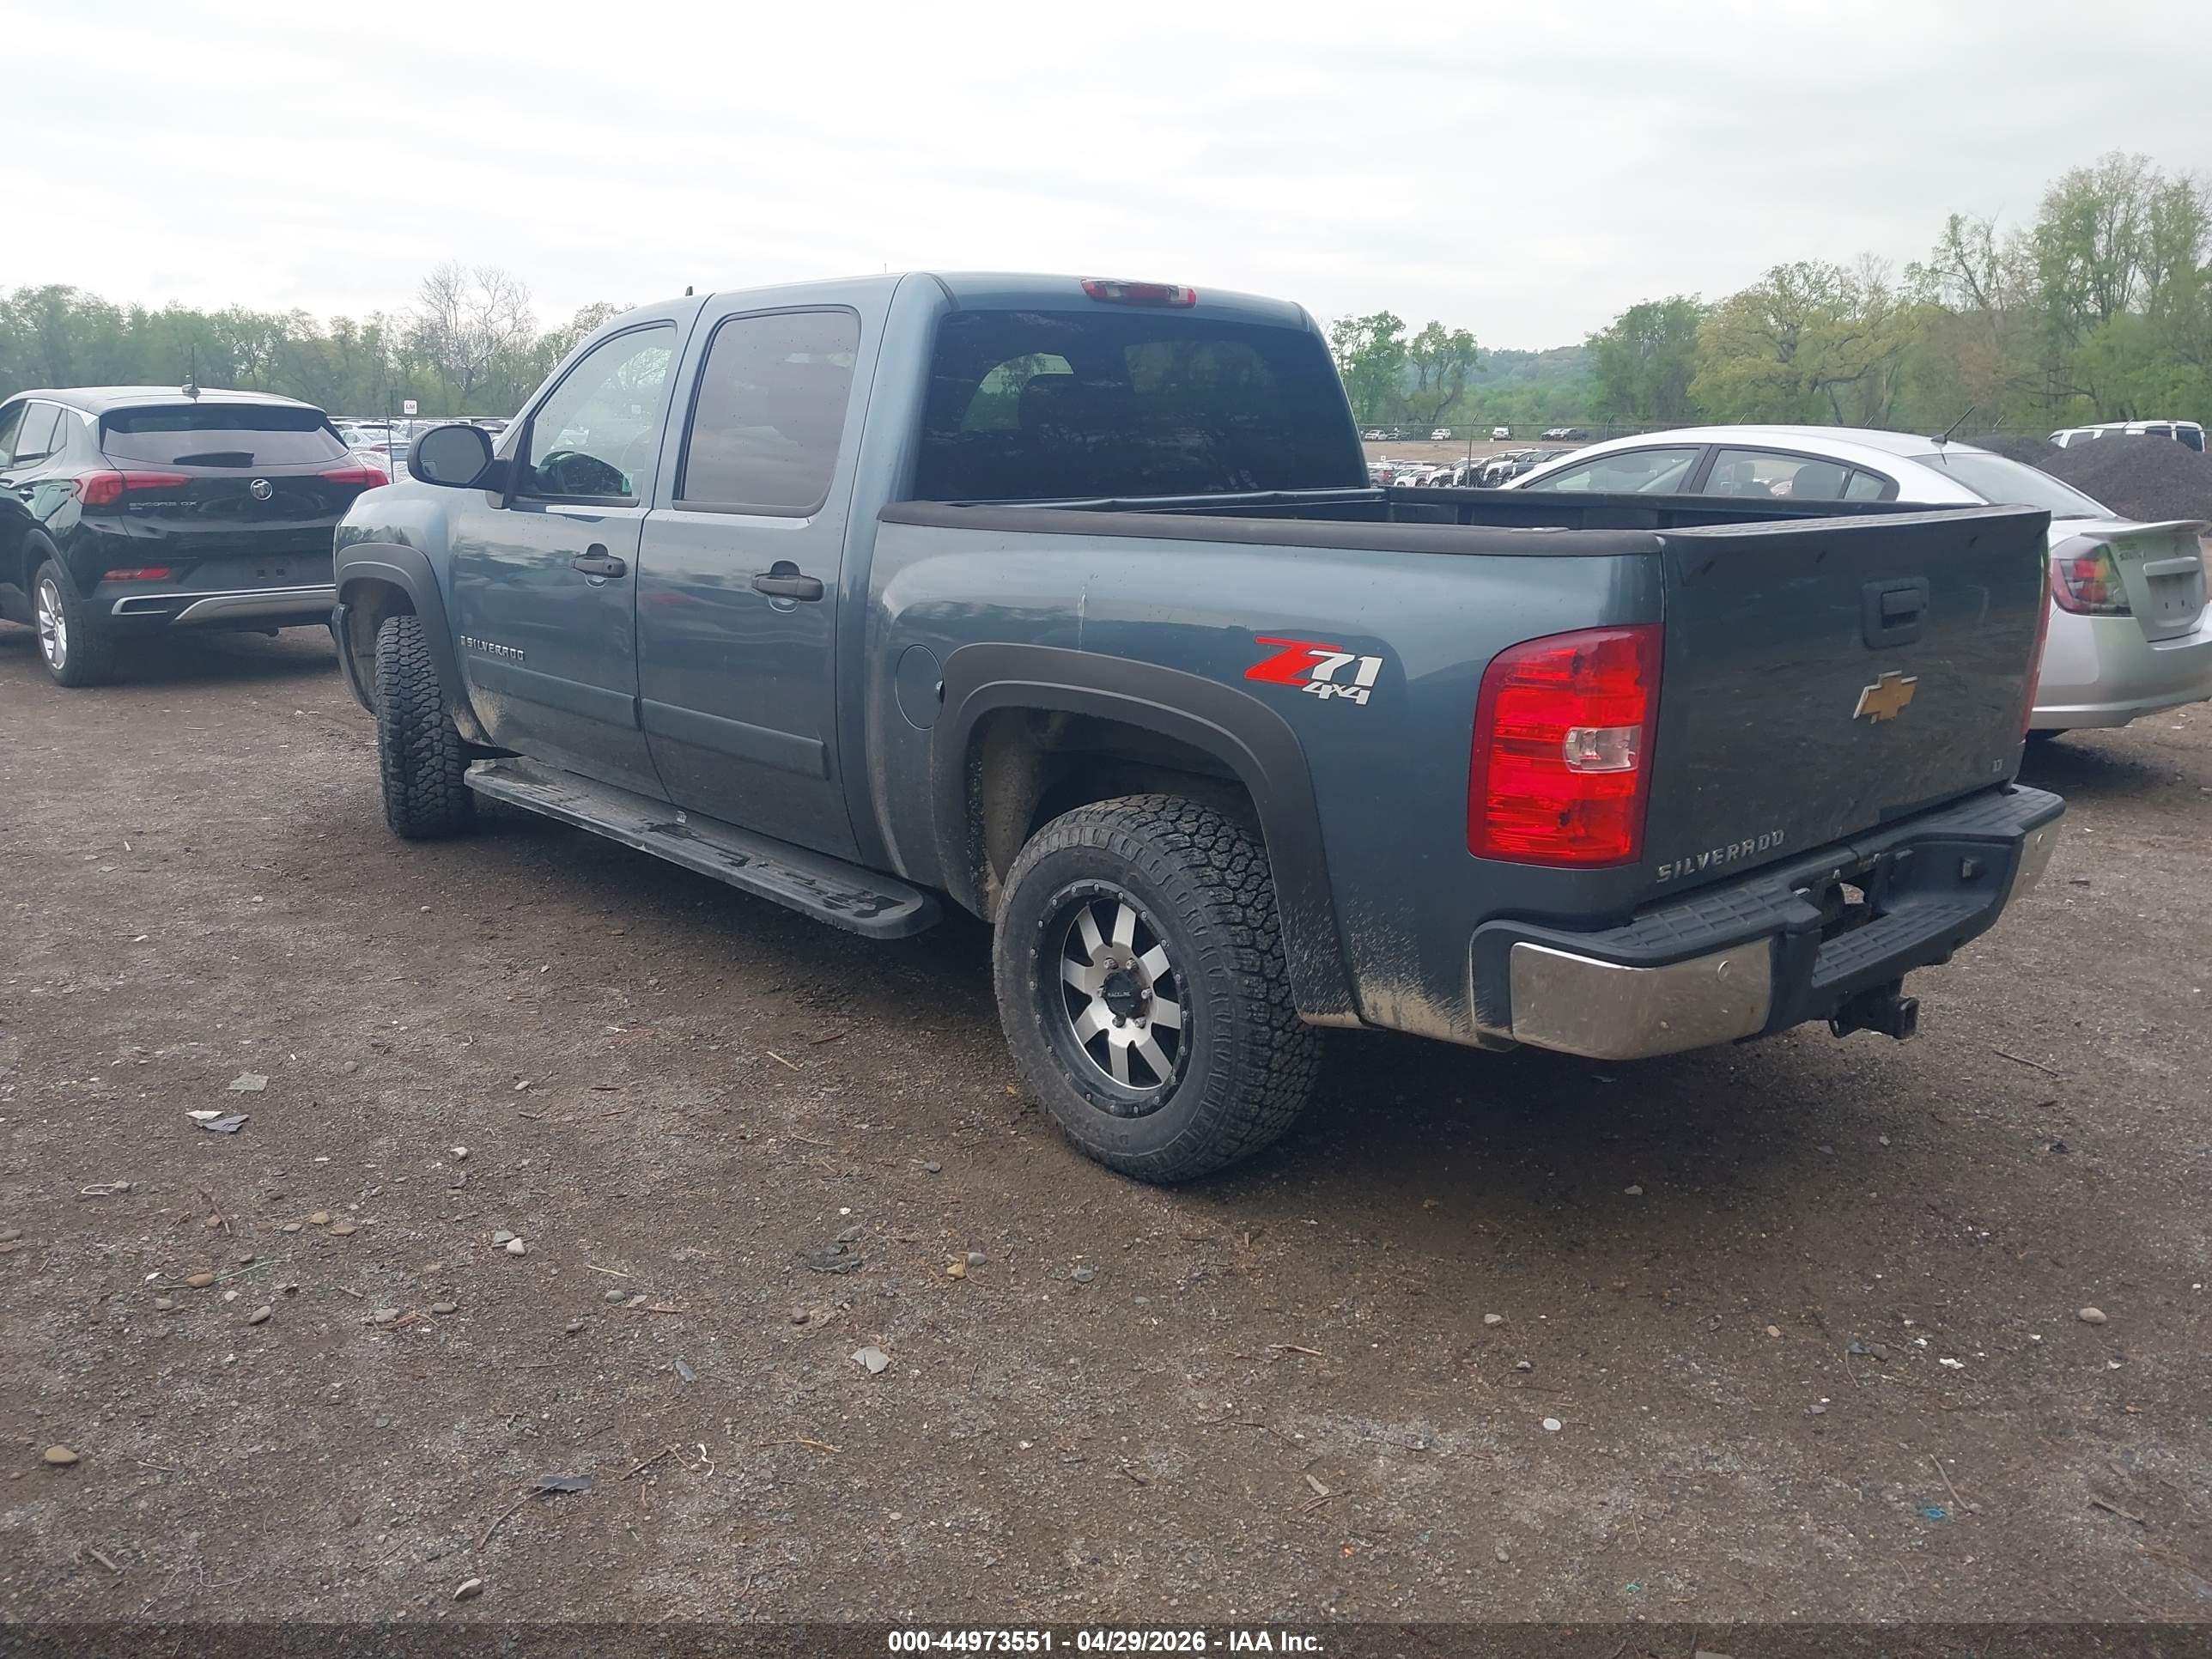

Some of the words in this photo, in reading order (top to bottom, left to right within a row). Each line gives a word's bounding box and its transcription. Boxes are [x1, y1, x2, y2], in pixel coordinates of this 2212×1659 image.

[466, 637, 525, 660] SILVERADO
[1244, 636, 1384, 688] Z71
[1656, 830, 1784, 884] SILVERADO
